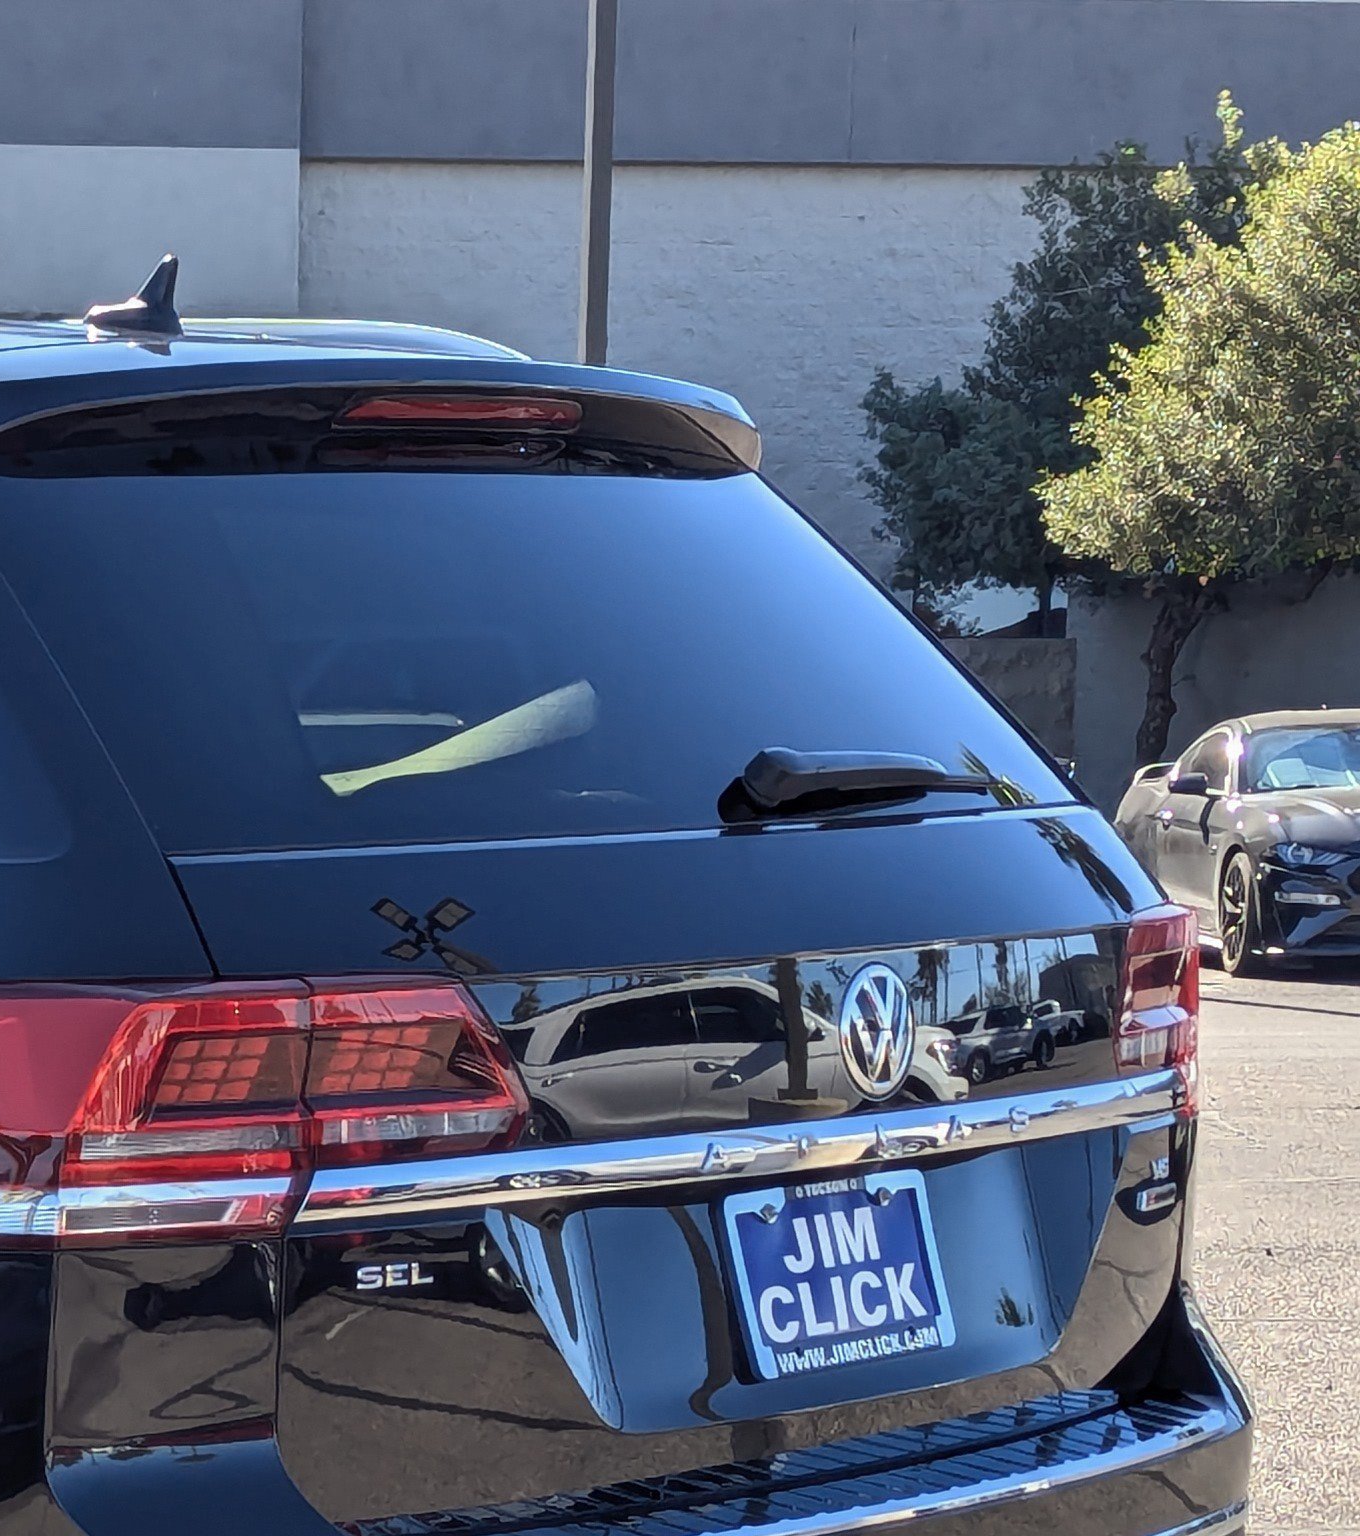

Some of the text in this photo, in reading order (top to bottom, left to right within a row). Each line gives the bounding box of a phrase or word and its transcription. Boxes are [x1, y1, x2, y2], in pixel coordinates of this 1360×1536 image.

[783, 1206, 880, 1274] JIM
[356, 1262, 434, 1290] SEL
[760, 1263, 927, 1344] CLICK
[776, 1326, 940, 1374] WWW.JIMCLICK.COM
